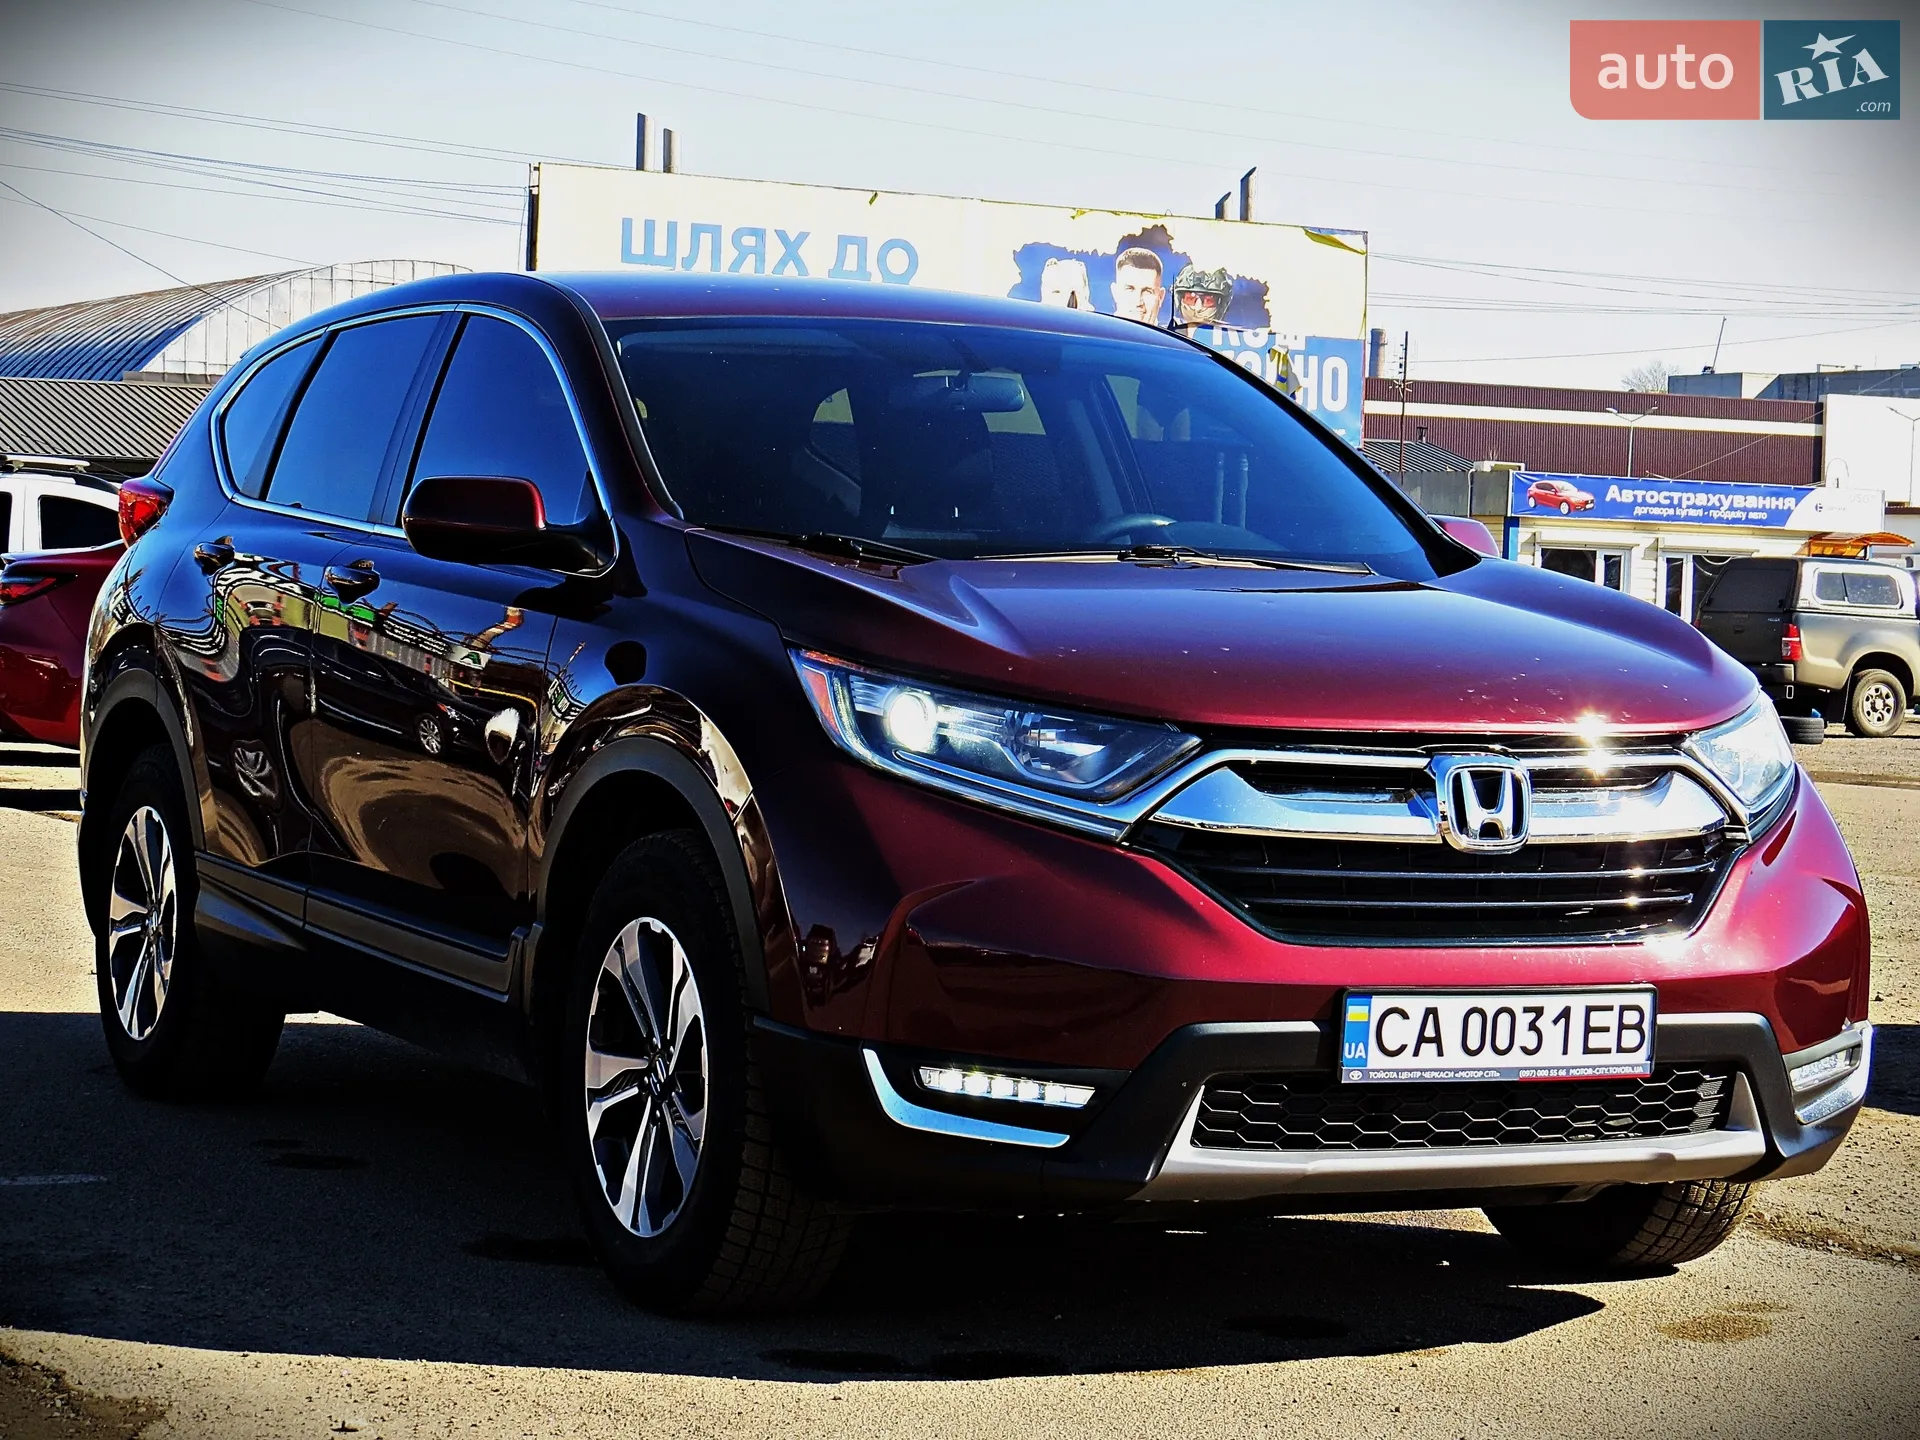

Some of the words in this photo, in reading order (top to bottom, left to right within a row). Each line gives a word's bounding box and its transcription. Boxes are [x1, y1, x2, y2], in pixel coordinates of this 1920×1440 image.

[620, 217, 812, 278] ШЛЯХ
[827, 234, 920, 286] ДО
[1605, 484, 1797, 511] Автострахування
[1344, 1042, 1367, 1059] UA
[1375, 1006, 1445, 1058] CA
